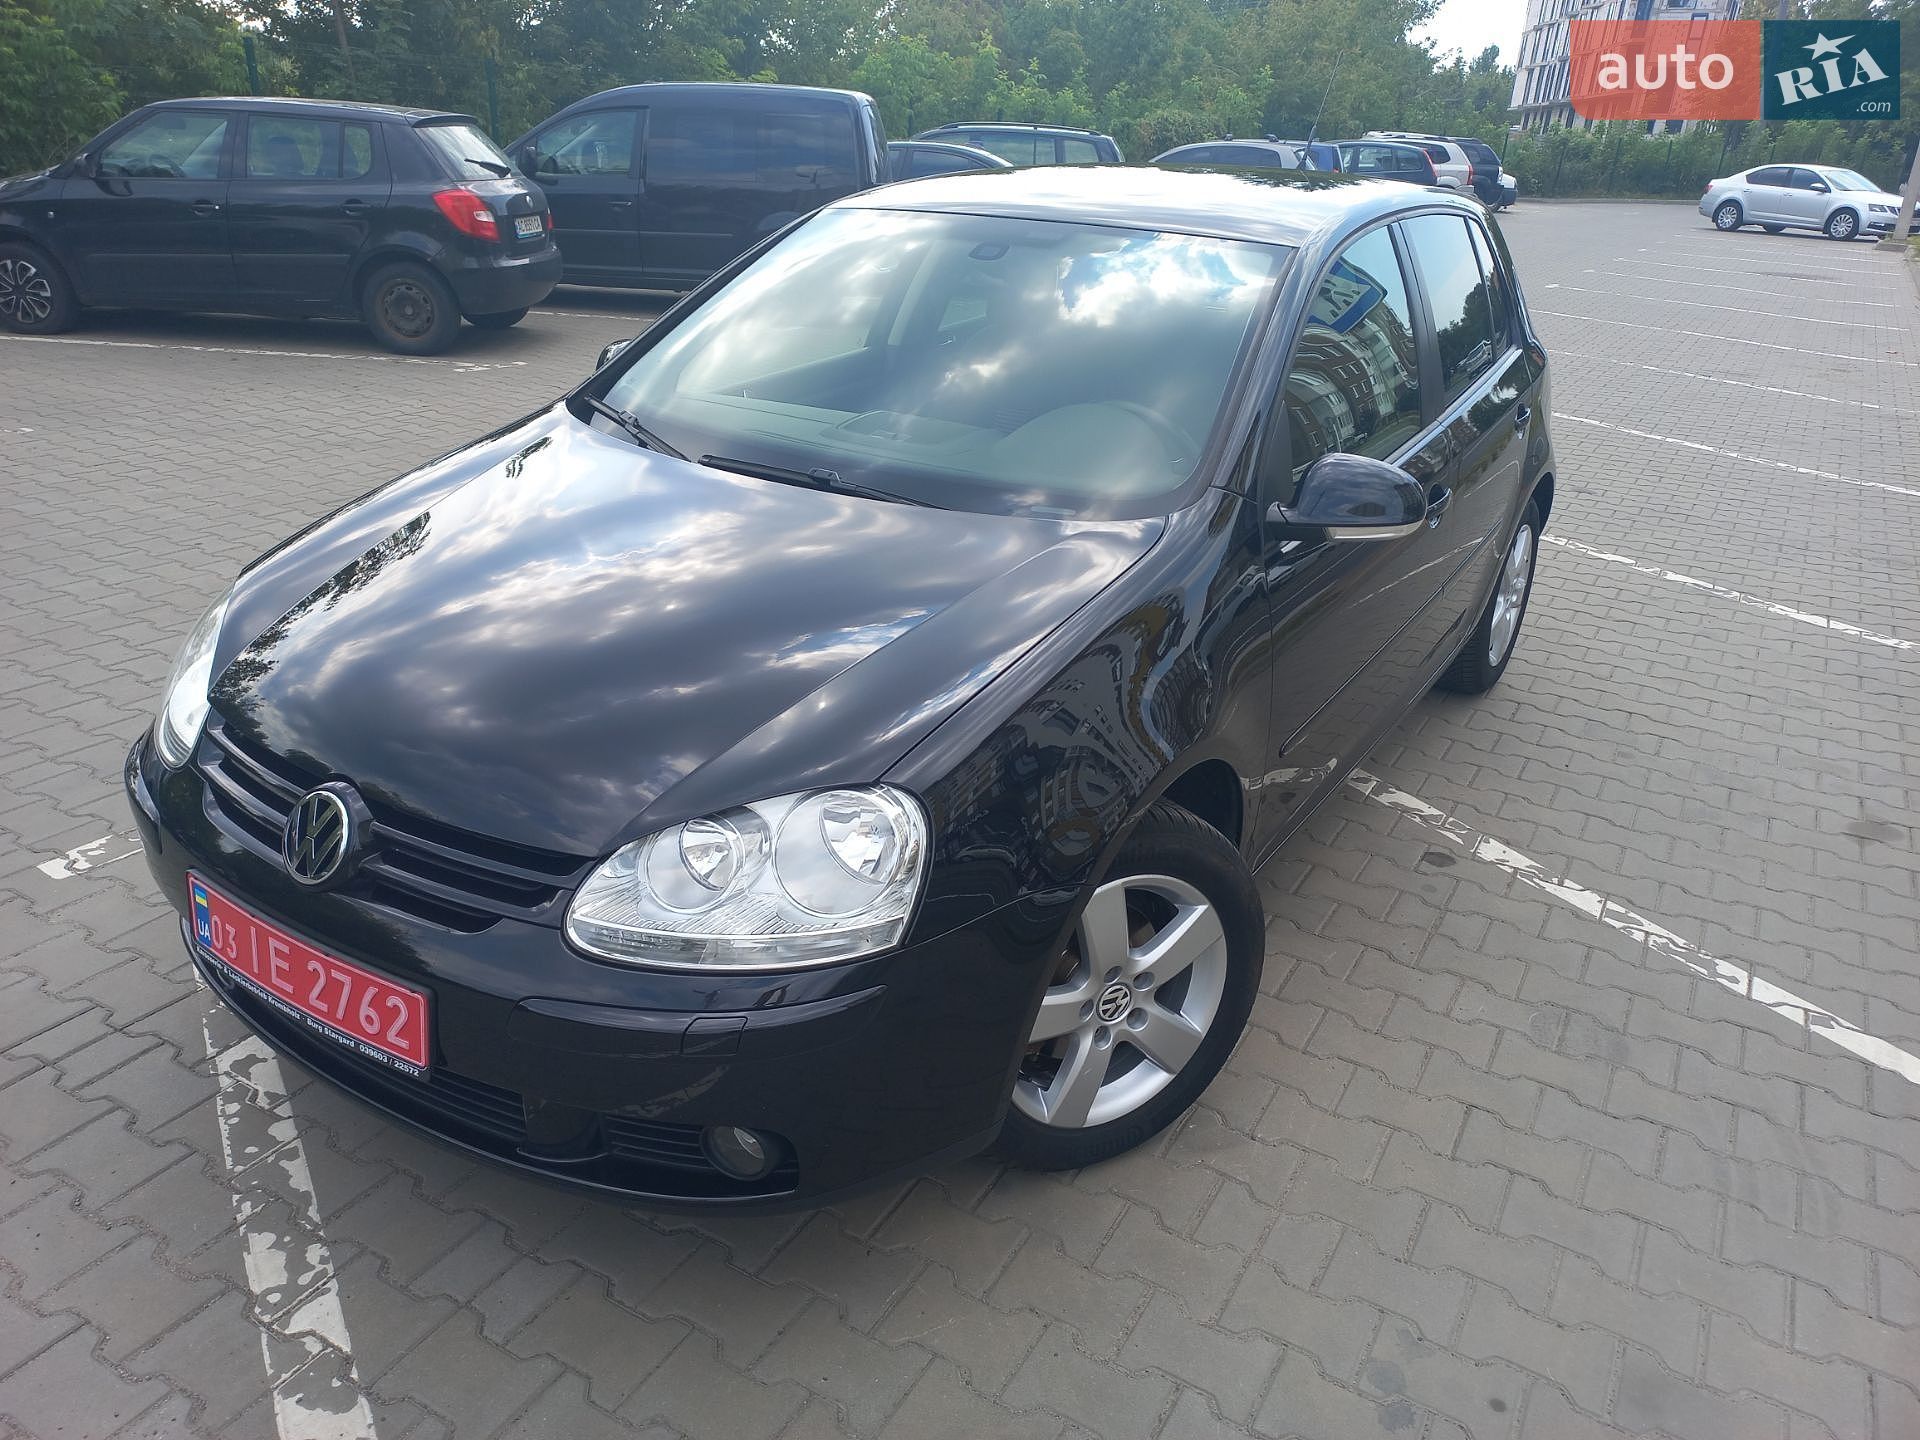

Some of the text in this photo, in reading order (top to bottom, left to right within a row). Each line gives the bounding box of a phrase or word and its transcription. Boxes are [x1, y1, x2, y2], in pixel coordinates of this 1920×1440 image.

[198, 918, 211, 942] UA
[211, 914, 411, 1050] 03 IE 2762
[307, 1018, 323, 1034] Burg
[324, 1027, 355, 1048] Stargard
[359, 1044, 388, 1063] 039603
[394, 1060, 420, 1077] 22572
